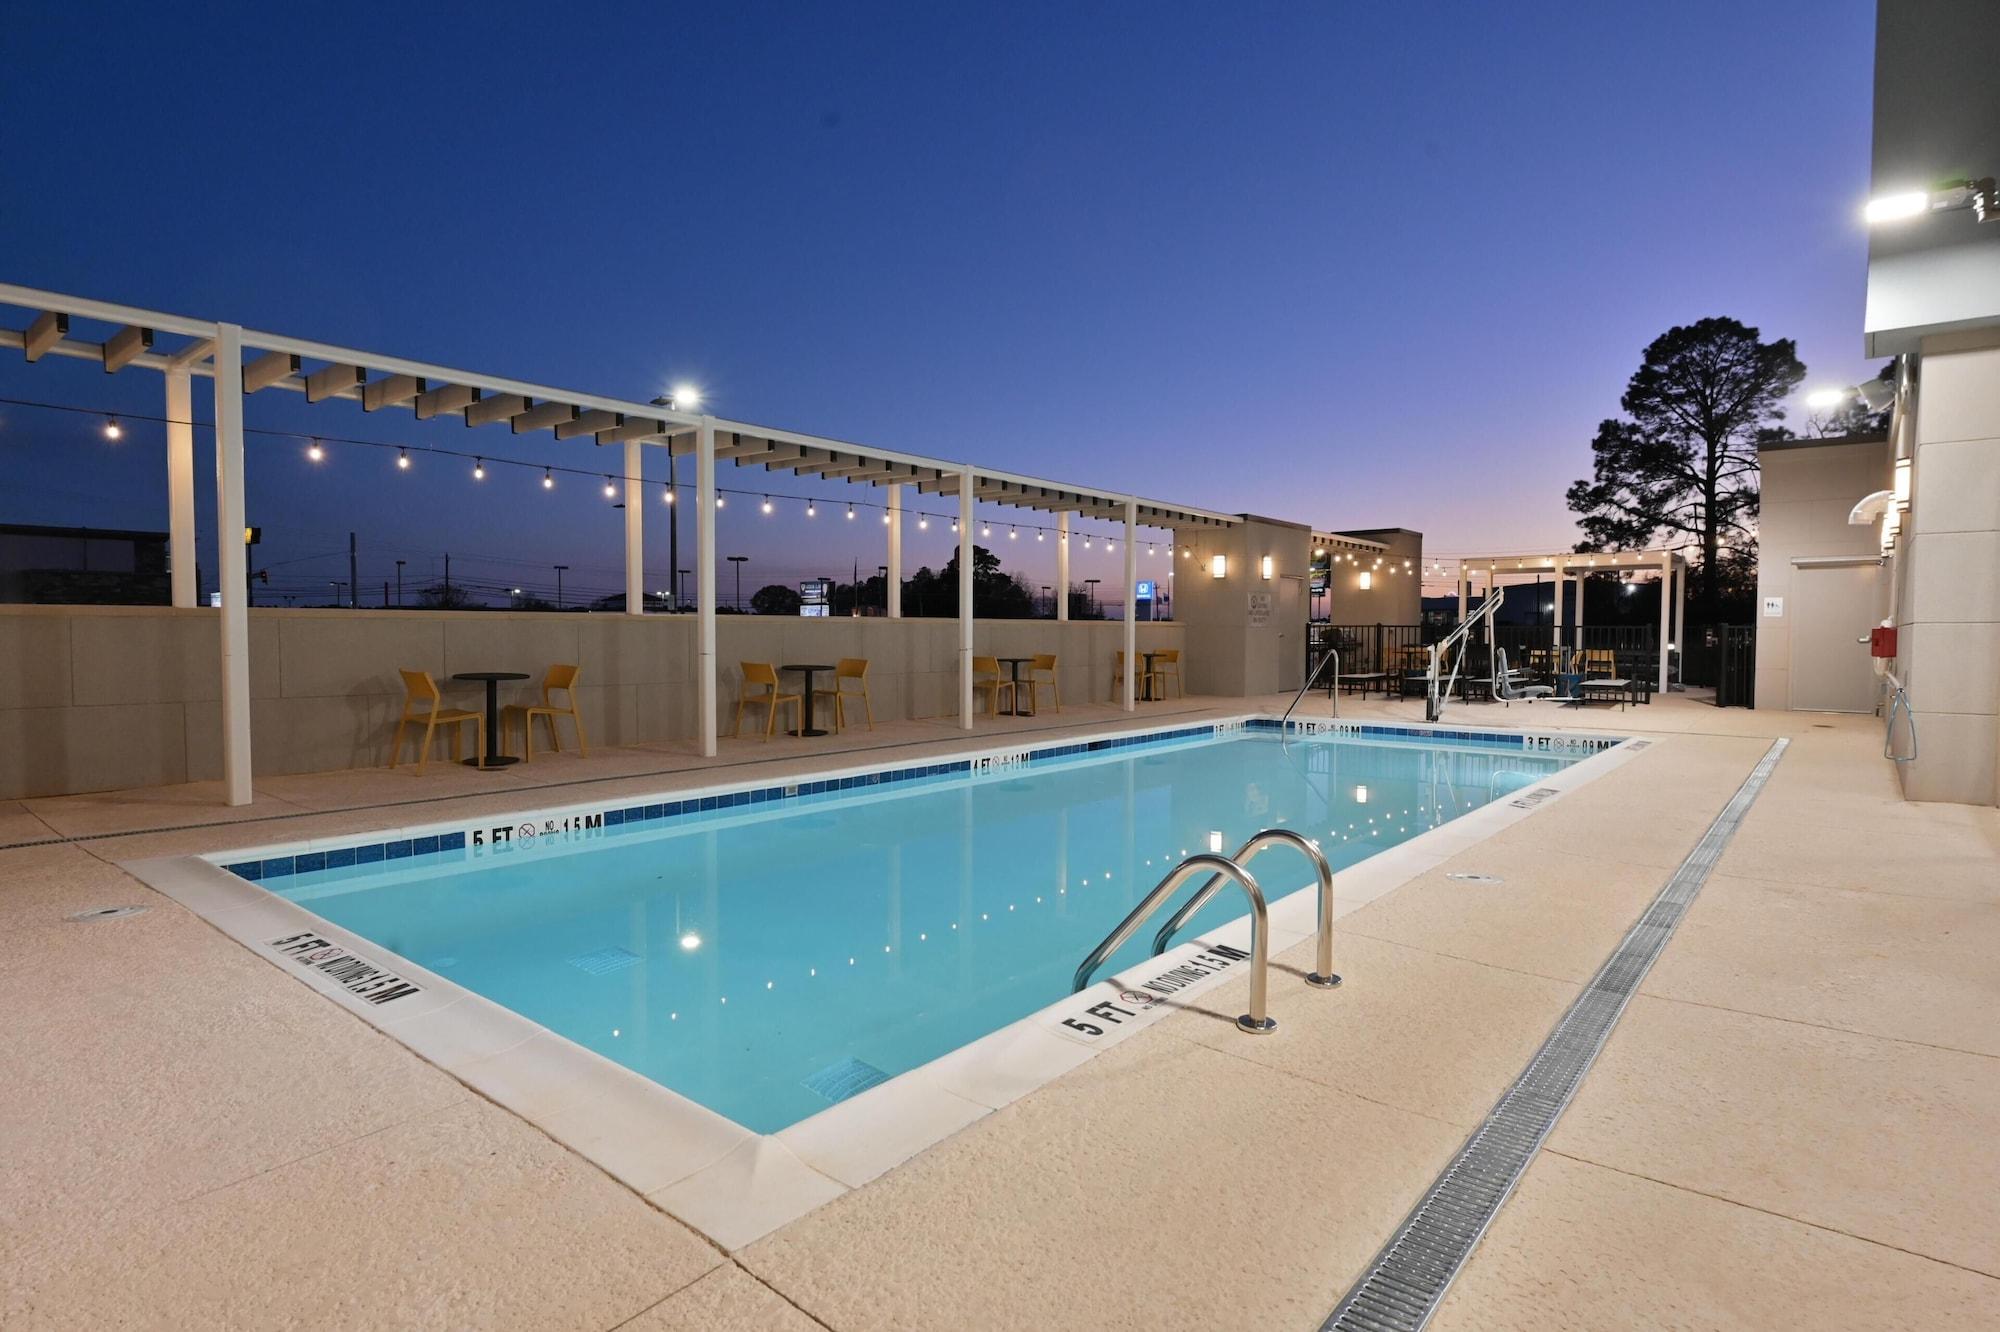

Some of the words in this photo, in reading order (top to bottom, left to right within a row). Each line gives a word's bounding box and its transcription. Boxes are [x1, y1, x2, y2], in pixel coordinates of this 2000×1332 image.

[1527, 736, 1534, 746] 3
[1538, 737, 1551, 746] FT
[981, 757, 991, 769] FT
[473, 830, 484, 846] 5
[492, 826, 513, 843] FT
[545, 820, 554, 831] NO
[585, 813, 602, 830] M
[271, 933, 314, 946] 5
[279, 938, 332, 956] FT
[1206, 944, 1251, 962] M
[1187, 954, 1231, 972] 1.5
[346, 972, 401, 994] 1.5
[1155, 965, 1211, 988] DIVING
[363, 981, 421, 1005] M
[1141, 980, 1179, 996] NO
[1085, 1001, 1137, 1025] FT
[1061, 1017, 1105, 1036] 5
